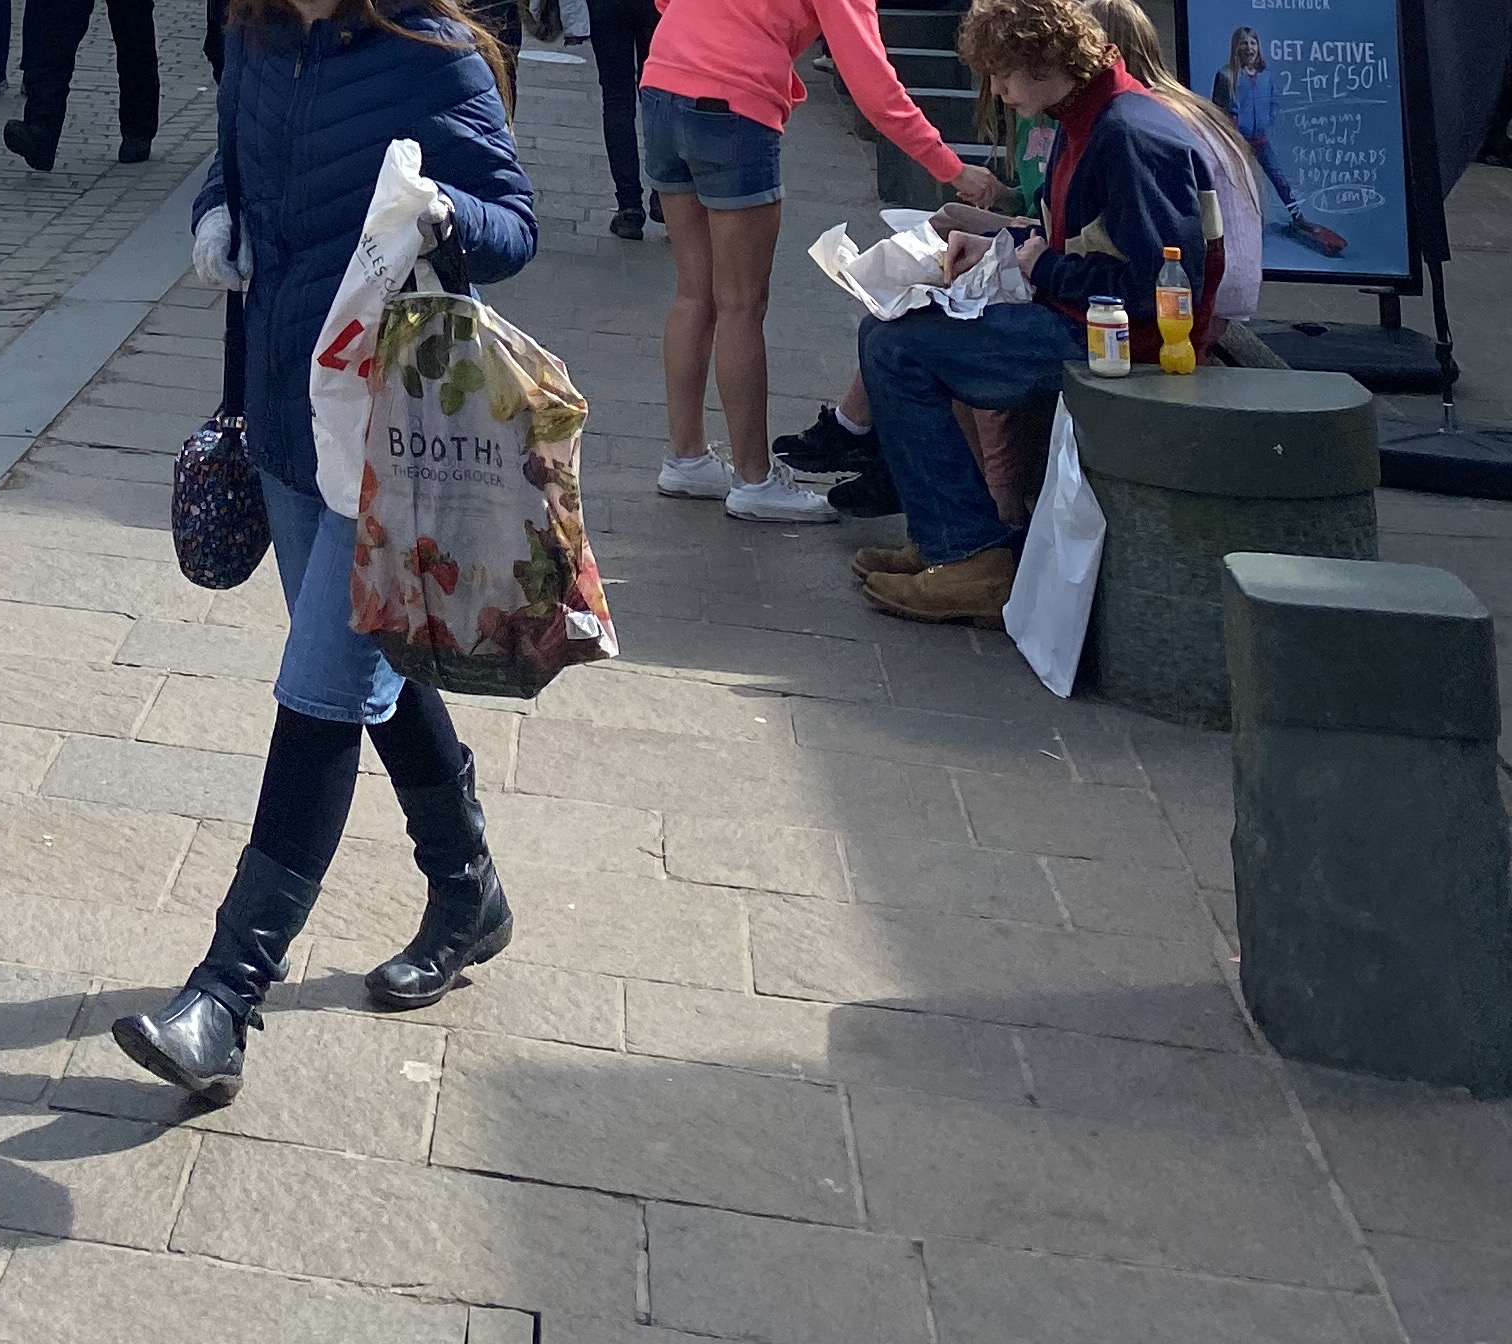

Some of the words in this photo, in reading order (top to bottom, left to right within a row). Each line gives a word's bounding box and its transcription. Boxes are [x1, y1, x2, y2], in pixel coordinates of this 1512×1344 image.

[1270, 39, 1304, 61] GET
[1309, 41, 1375, 63] ACTIVE
[1280, 70, 1301, 96] 2
[1301, 66, 1329, 102] for
[1294, 113, 1362, 135] Changing
[1292, 146, 1387, 168] SKATEBOARDS
[389, 427, 502, 468] BOOTHS
[391, 464, 414, 479] THE
[414, 467, 448, 482] GOOD
